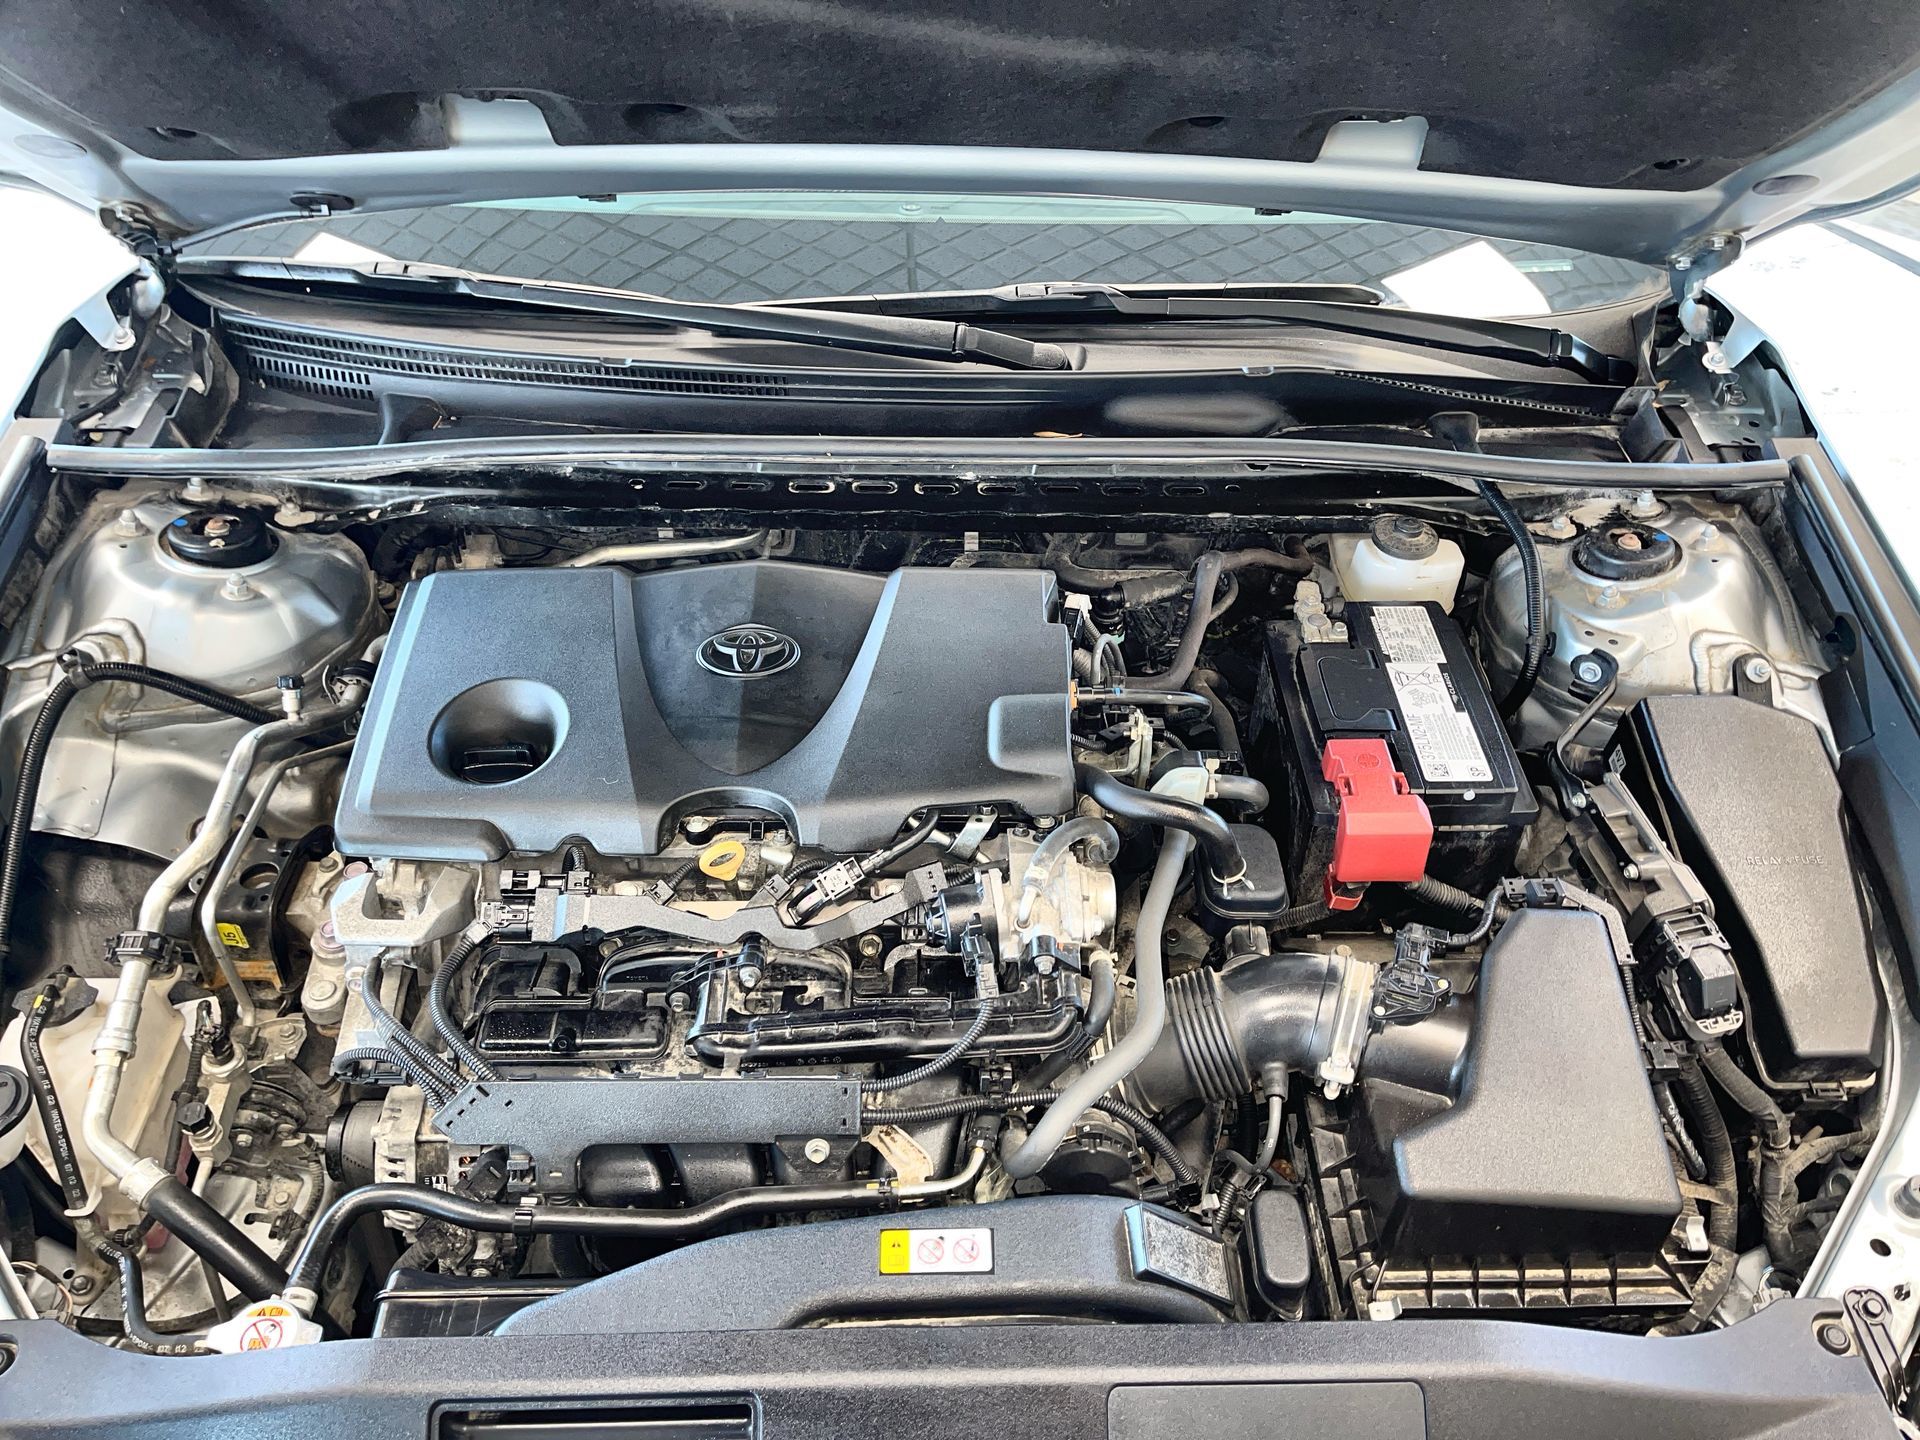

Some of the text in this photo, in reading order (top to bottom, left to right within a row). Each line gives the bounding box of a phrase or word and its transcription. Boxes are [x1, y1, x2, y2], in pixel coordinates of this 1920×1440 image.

[1443, 672, 1456, 695] CLARIOS
[1746, 855, 1781, 865] RELAY
[1794, 855, 1824, 865] FUSE
[28, 1016, 42, 1037] WATER
[50, 1108, 63, 1134] WATER
